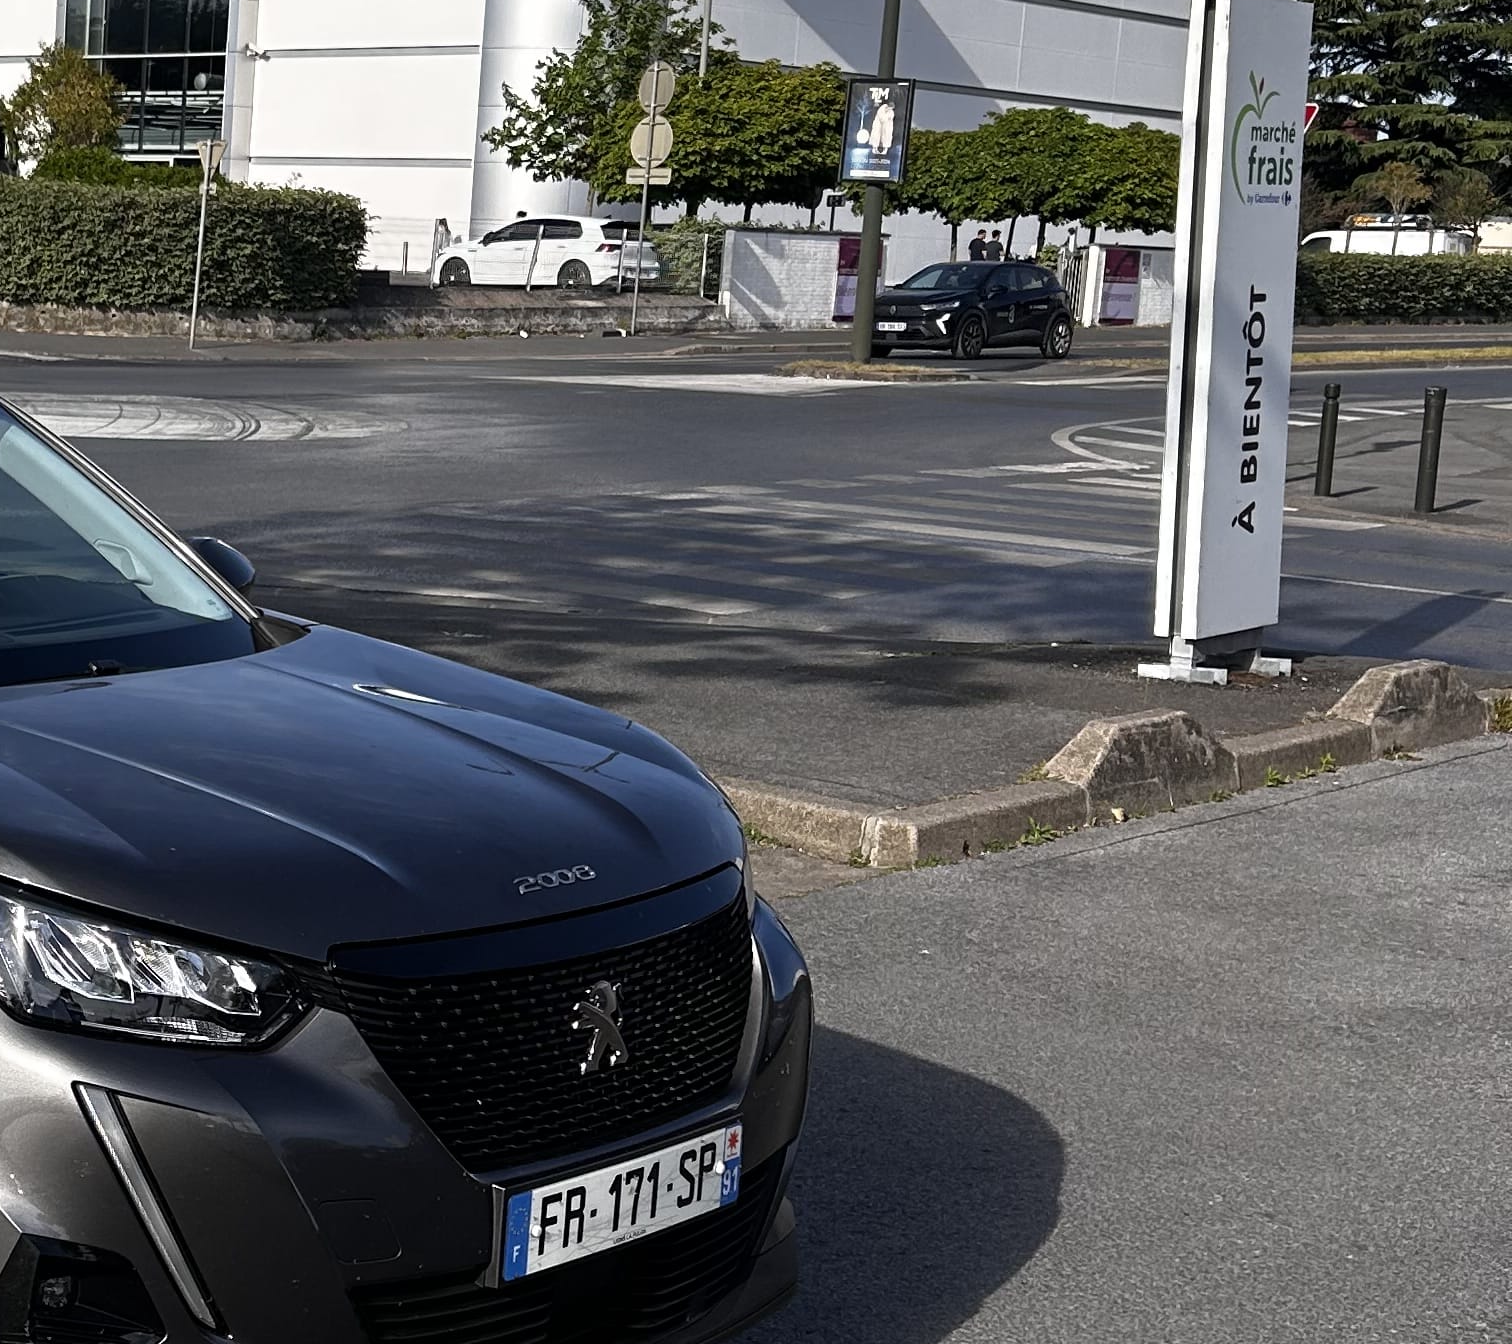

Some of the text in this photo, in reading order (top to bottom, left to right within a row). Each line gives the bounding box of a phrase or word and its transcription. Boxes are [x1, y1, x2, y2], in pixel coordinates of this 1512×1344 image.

[1251, 120, 1296, 144] marché
[1248, 145, 1294, 186] frais
[1232, 283, 1267, 534] À BIENTÔT
[513, 864, 597, 895] 2008
[722, 1165, 740, 1196] 91
[511, 1245, 521, 1264] F
